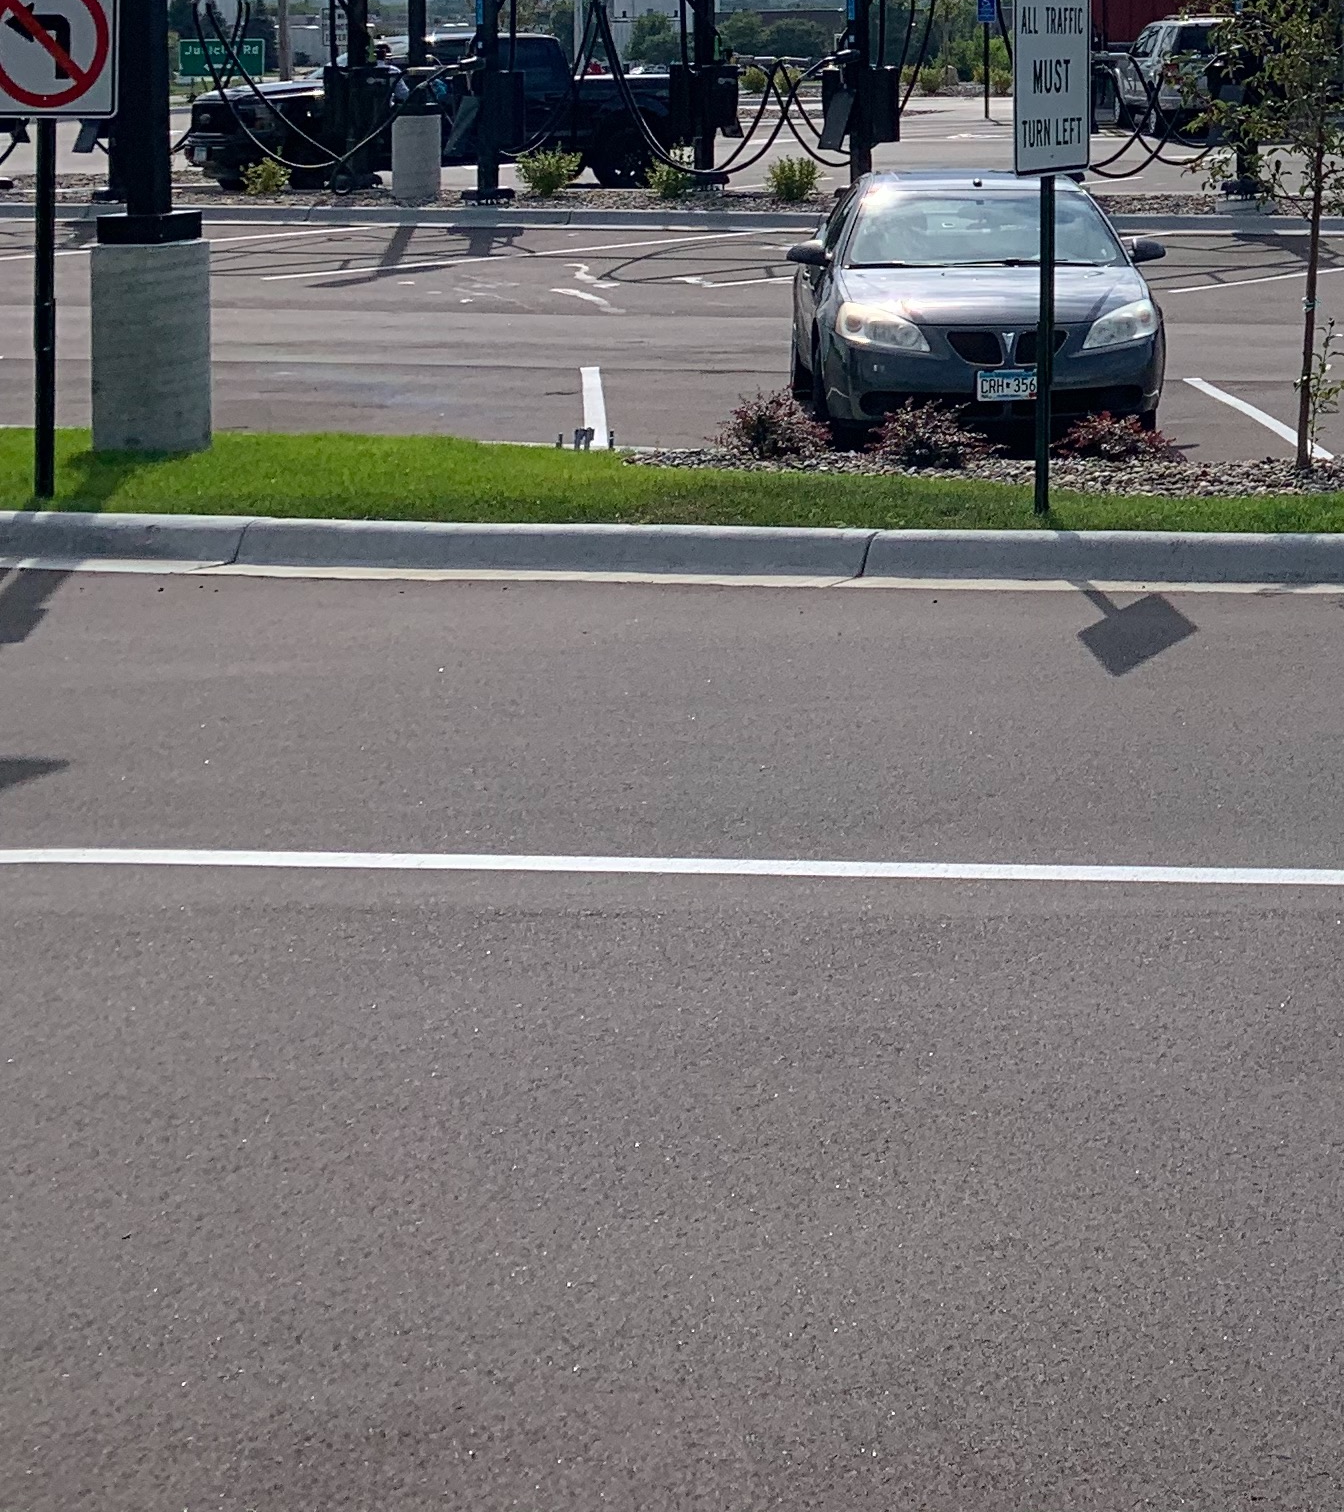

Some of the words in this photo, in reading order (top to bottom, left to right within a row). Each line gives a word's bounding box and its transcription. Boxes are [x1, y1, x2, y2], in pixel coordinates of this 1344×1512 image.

[1021, 6, 1039, 35] ALL
[1045, 6, 1084, 35] TRAFFIC
[243, 45, 259, 55] Rd
[1033, 59, 1071, 94] MUST
[1021, 119, 1051, 149] TURN
[1055, 117, 1082, 146] LEFT
[981, 378, 1004, 394] CRH
[1013, 377, 1036, 393] 356
